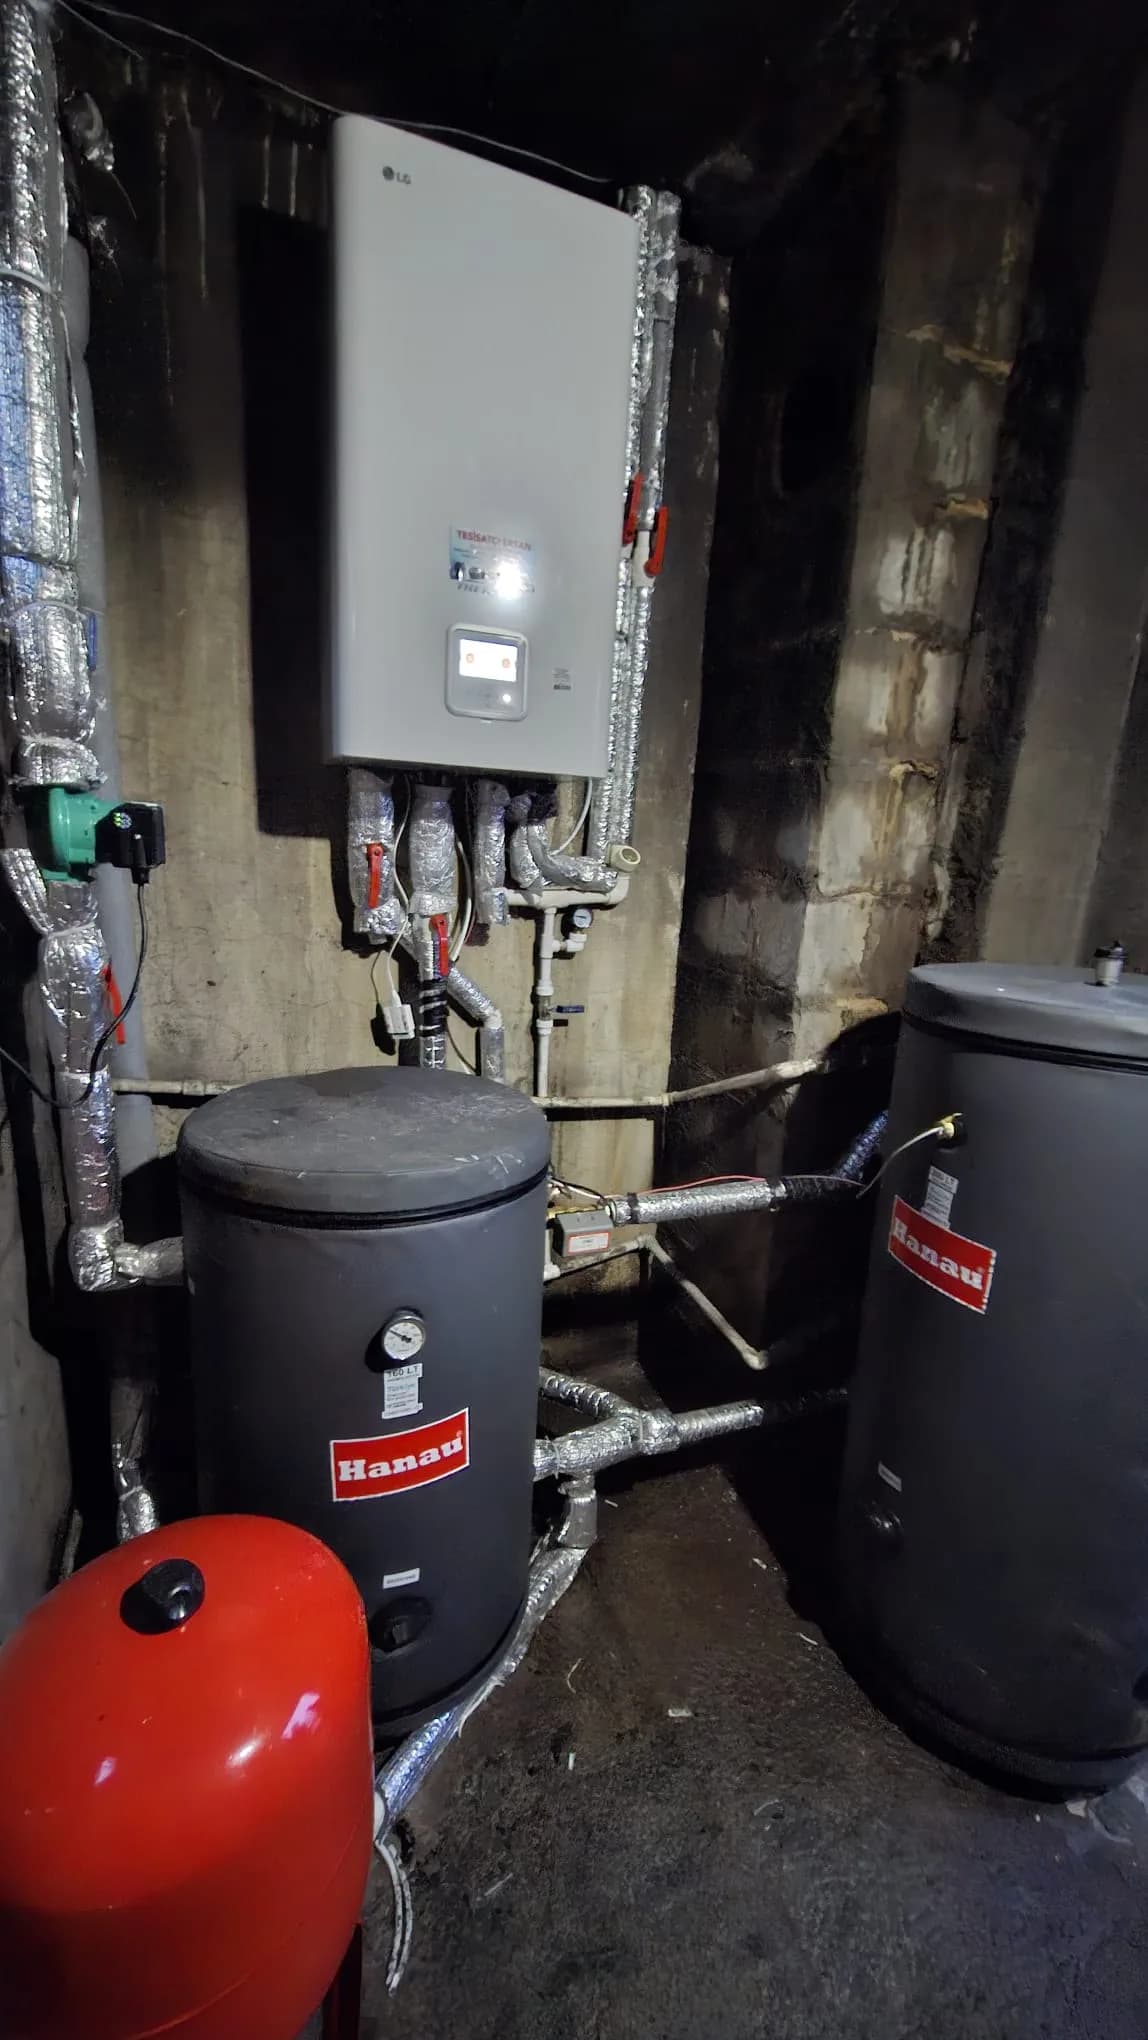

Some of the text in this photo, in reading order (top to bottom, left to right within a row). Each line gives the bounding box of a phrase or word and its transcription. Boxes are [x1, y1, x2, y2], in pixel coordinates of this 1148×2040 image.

[396, 171, 411, 185] LG
[893, 1217, 983, 1291] Hanau
[338, 1437, 463, 1482] Hanau
